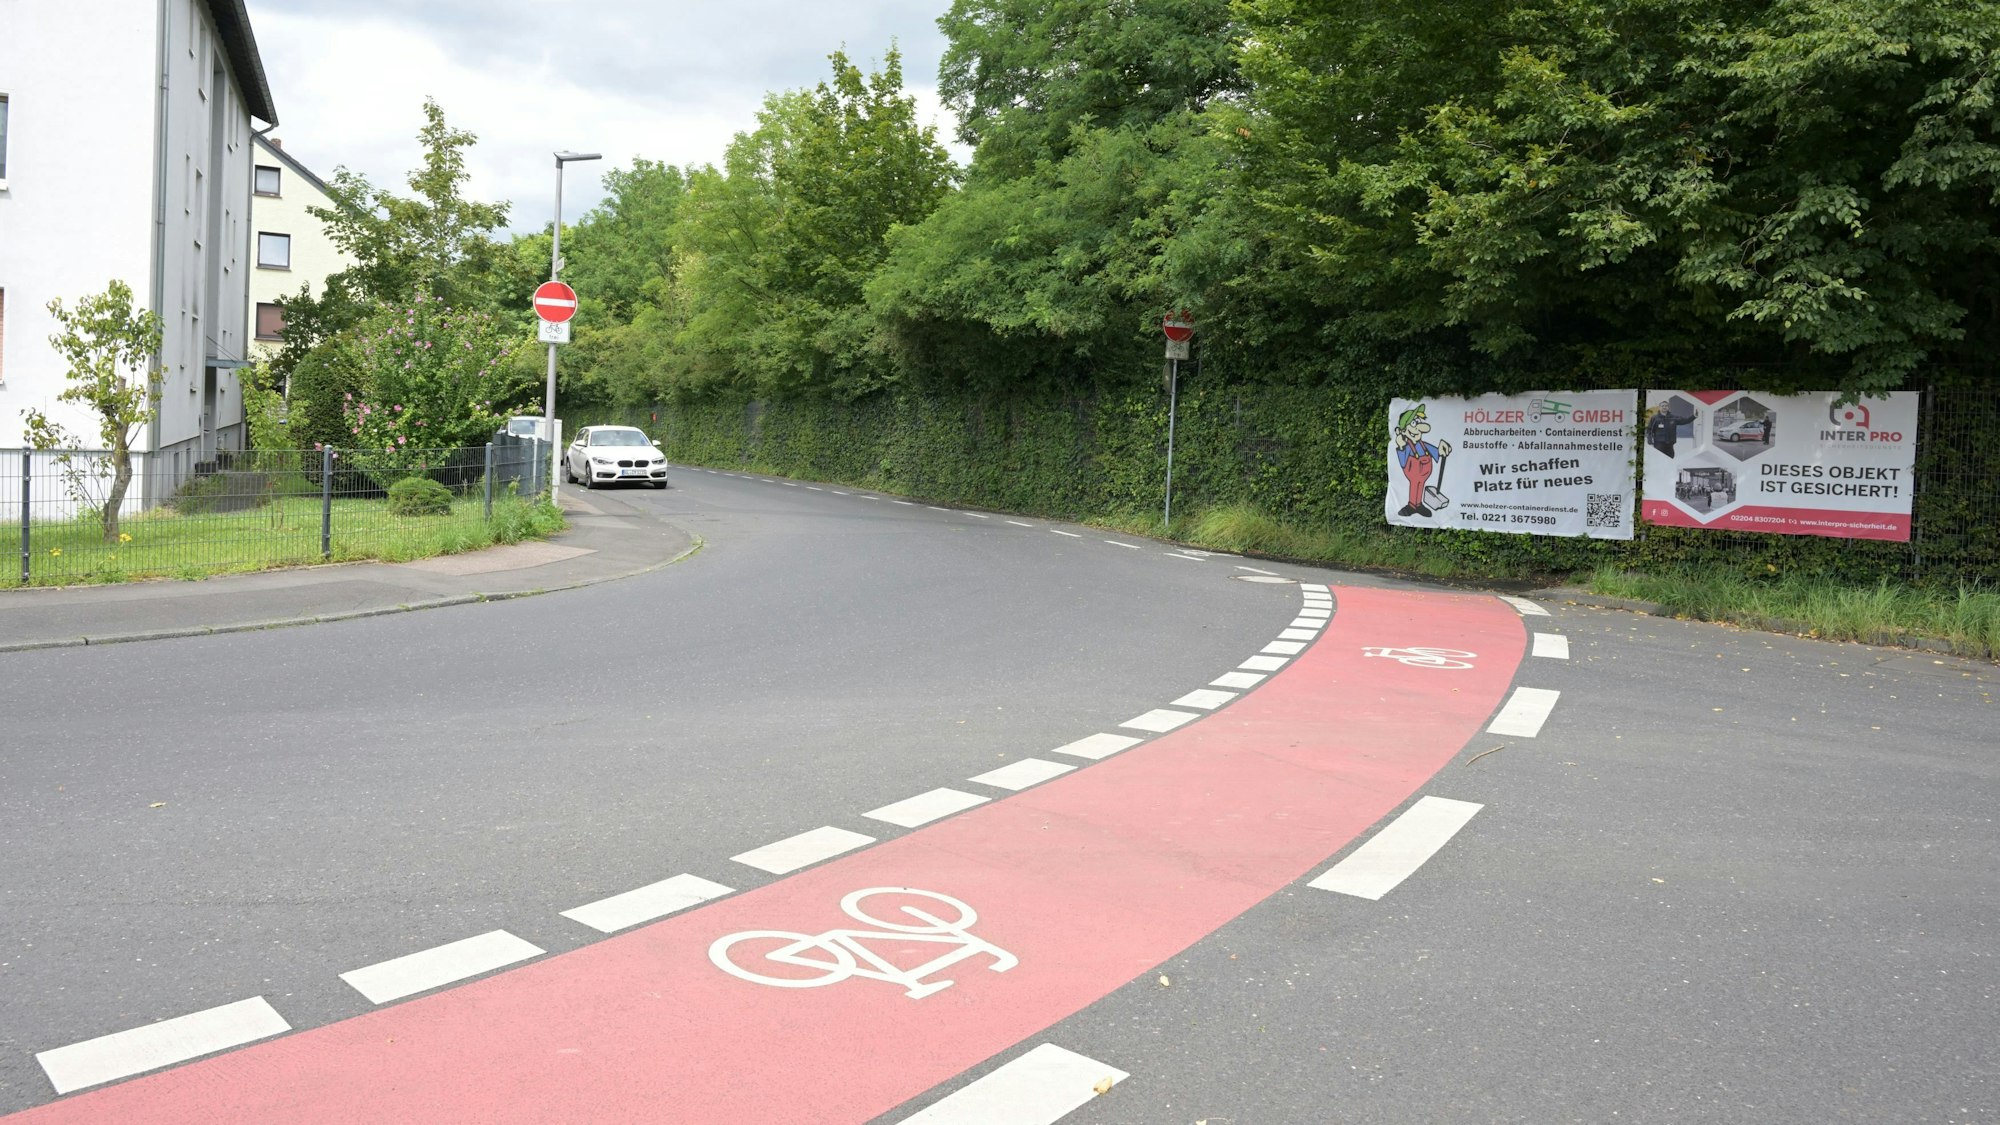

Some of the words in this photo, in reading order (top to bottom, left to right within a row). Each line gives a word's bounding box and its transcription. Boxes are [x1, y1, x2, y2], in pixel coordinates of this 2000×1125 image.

[1464, 408, 1525, 424] HÖLZER
[1572, 409, 1624, 423] GMBH
[1463, 427, 1537, 437] Abbrucharbeiten
[1545, 427, 1623, 438] Containerdienst
[1820, 430, 1866, 441] INTER
[1870, 431, 1903, 442] PRO
[1462, 440, 1508, 450] Baustoffe
[1518, 441, 1623, 451] Abfallannahmestelle
[1479, 463, 1507, 476] Wir
[1511, 457, 1580, 473] schaffen
[1760, 463, 1823, 478] DIESES
[1829, 465, 1901, 481] OBJEKT
[1473, 479, 1512, 493] Platz
[1516, 477, 1540, 490] für
[1544, 474, 1594, 488] neues
[1760, 480, 1787, 493] IST
[1791, 481, 1899, 498] GESICHERT!
[1460, 502, 1579, 514] www.hoelzer-containerdienst.de
[1460, 512, 1479, 521] Tel.
[1482, 513, 1507, 523] 0221
[1511, 514, 1556, 525] 3675980
[1730, 514, 1753, 522] 02204
[1754, 516, 1786, 524] 8307204
[1799, 519, 1897, 531] www.interpro-sicherheit.de
